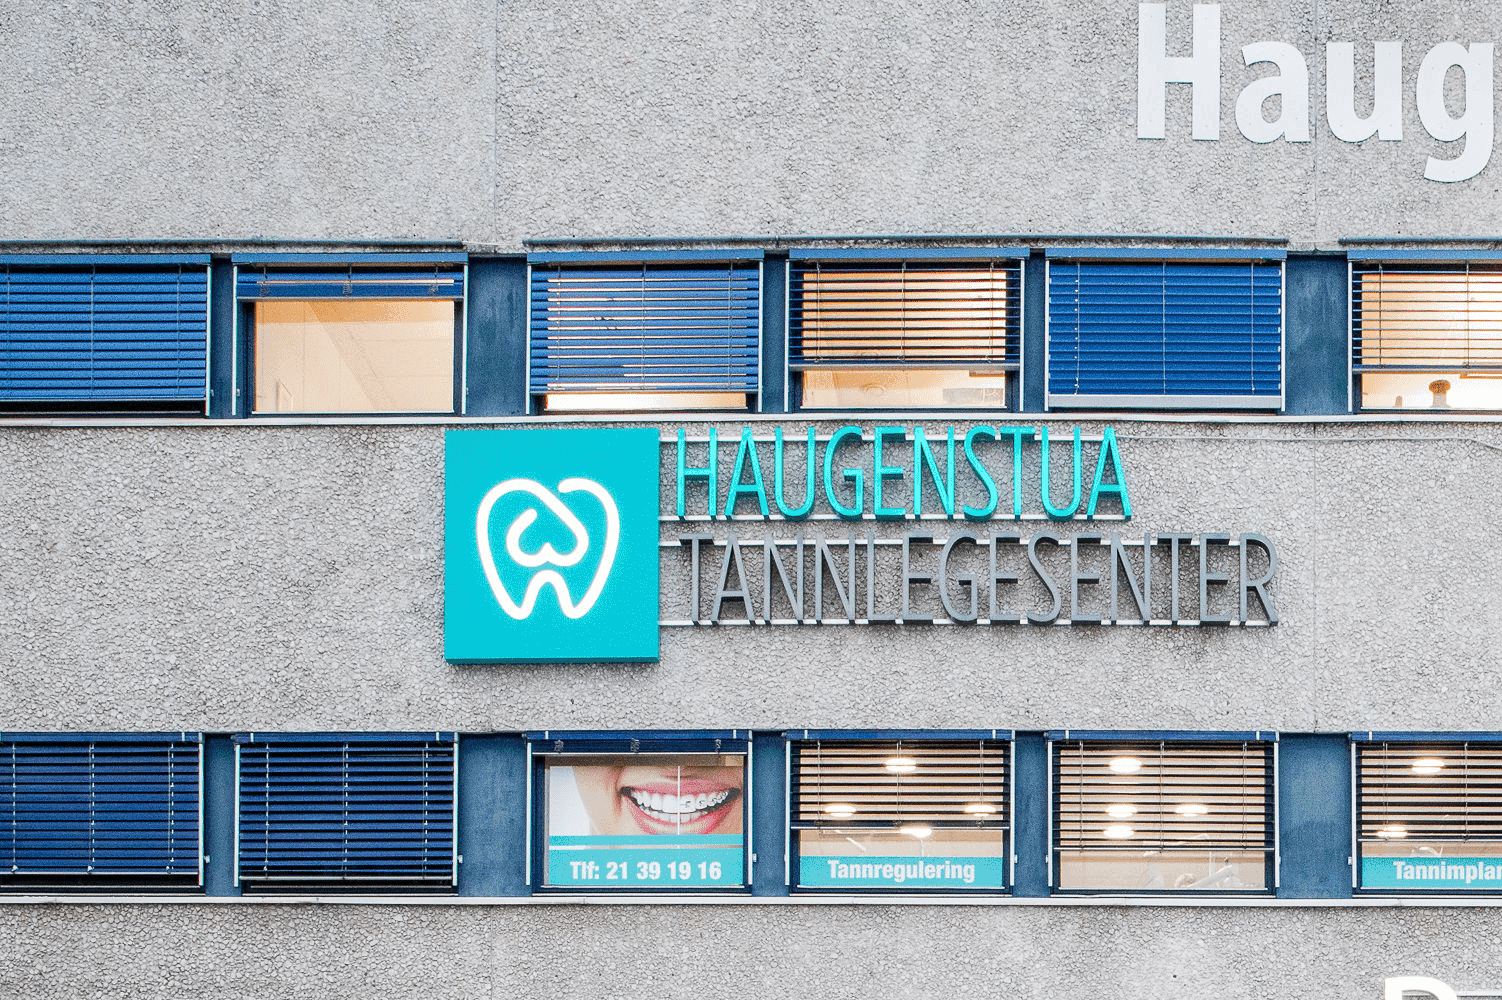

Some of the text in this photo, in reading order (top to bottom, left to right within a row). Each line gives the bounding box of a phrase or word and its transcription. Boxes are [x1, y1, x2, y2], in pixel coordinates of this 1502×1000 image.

[676, 425, 1132, 521] HAUGENSTUA
[679, 532, 1279, 626] TANNLEGESENTER
[569, 860, 722, 880] Tlf: 21 39 19 16
[827, 859, 975, 883] Tannregulering
